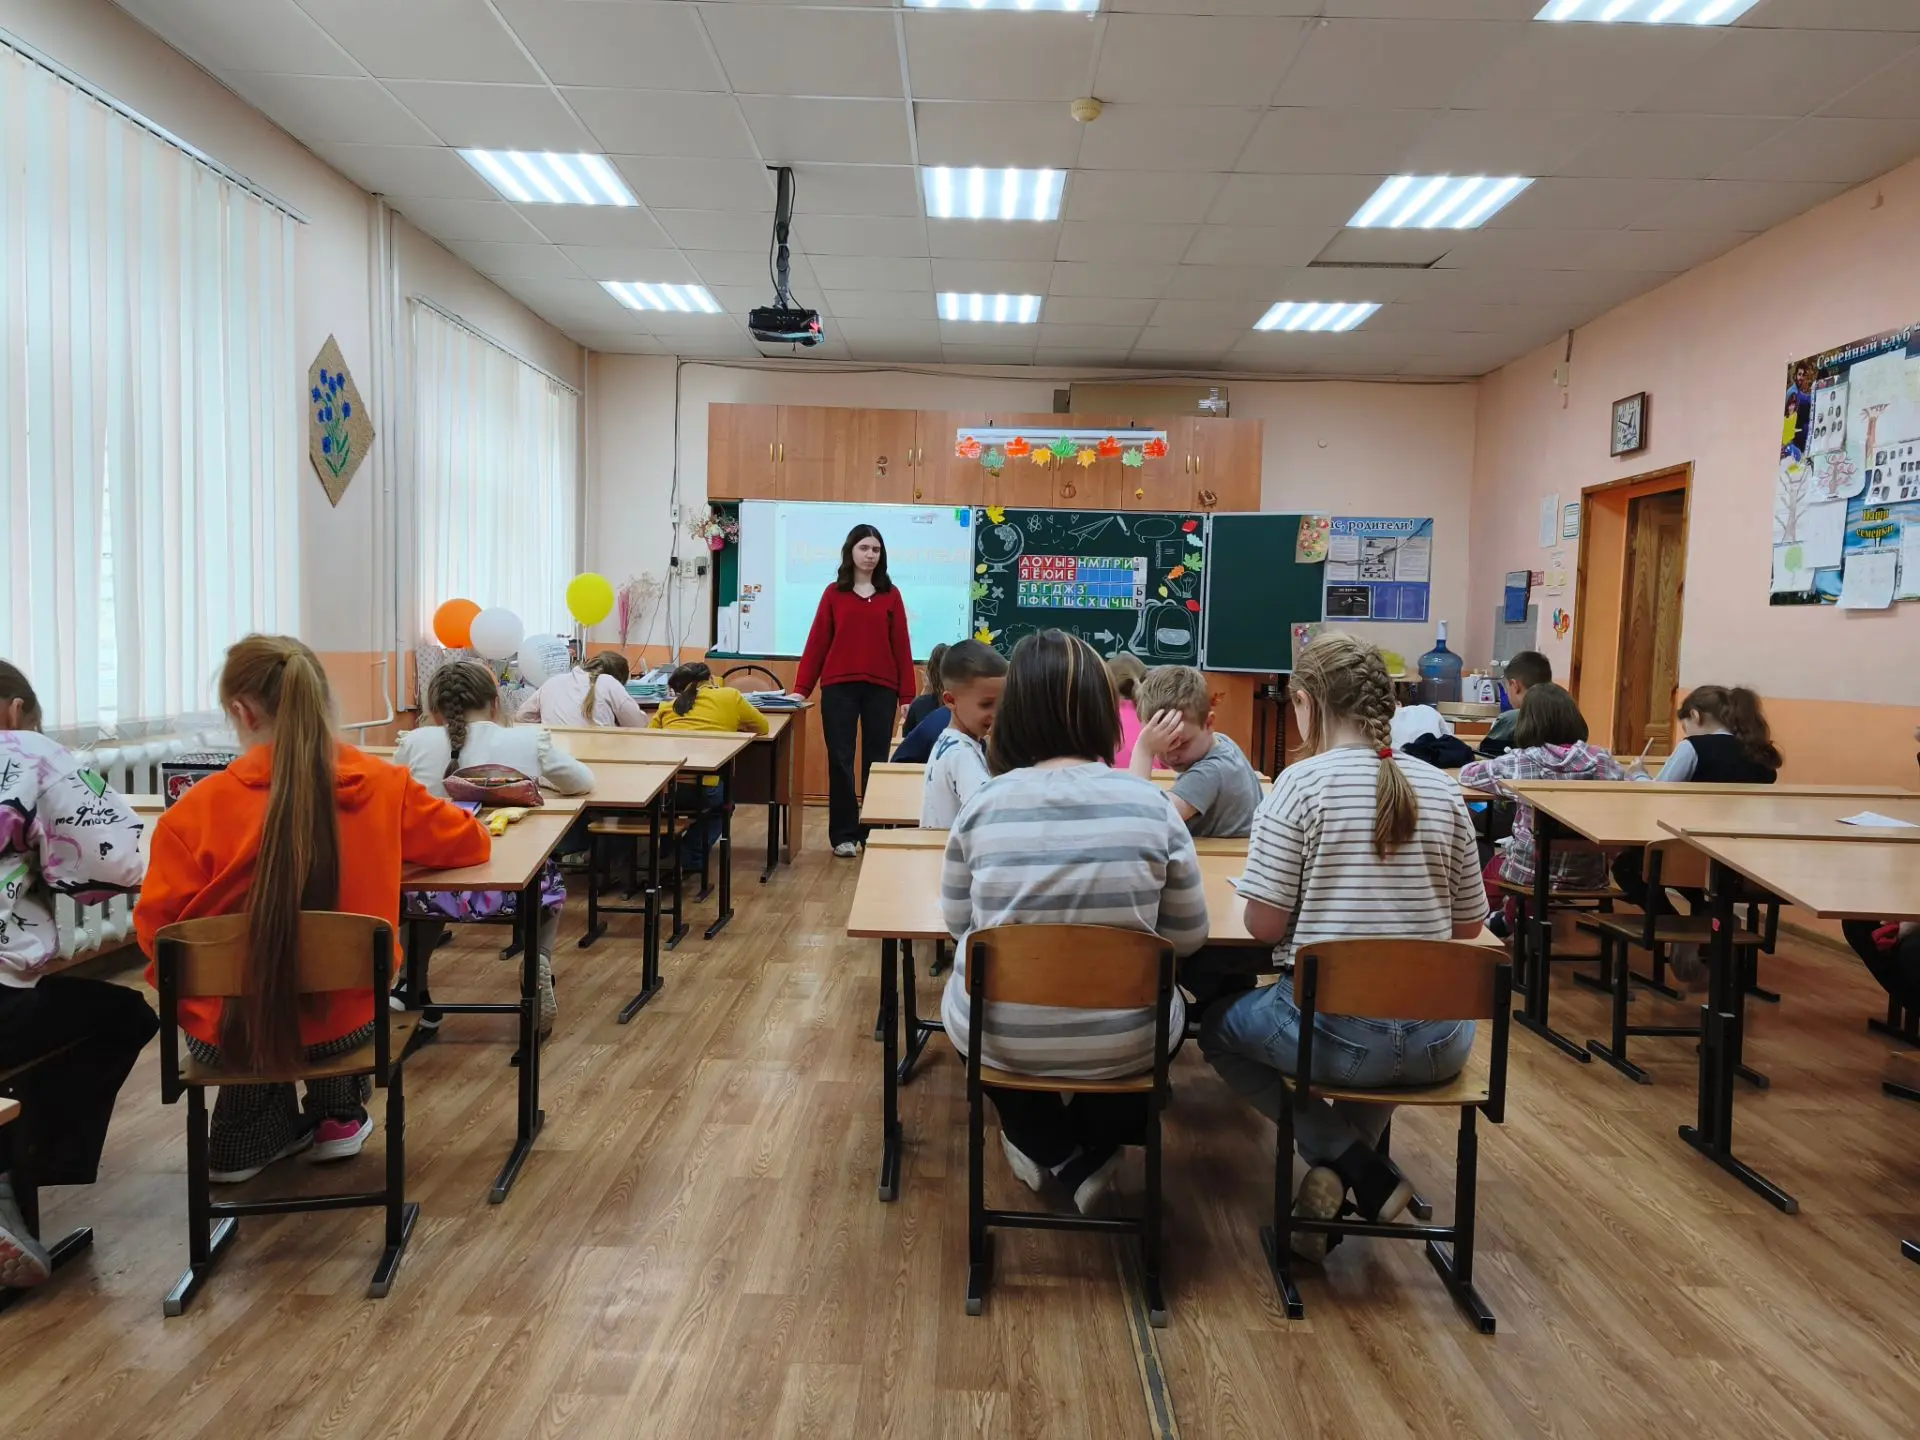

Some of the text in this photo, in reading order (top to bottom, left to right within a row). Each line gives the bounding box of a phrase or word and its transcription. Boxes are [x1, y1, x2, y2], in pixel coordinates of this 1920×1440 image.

[1816, 336, 1877, 370] Семейный
[1881, 326, 1911, 349] клуб
[1349, 519, 1414, 533] родители!
[75, 805, 115, 827] give
